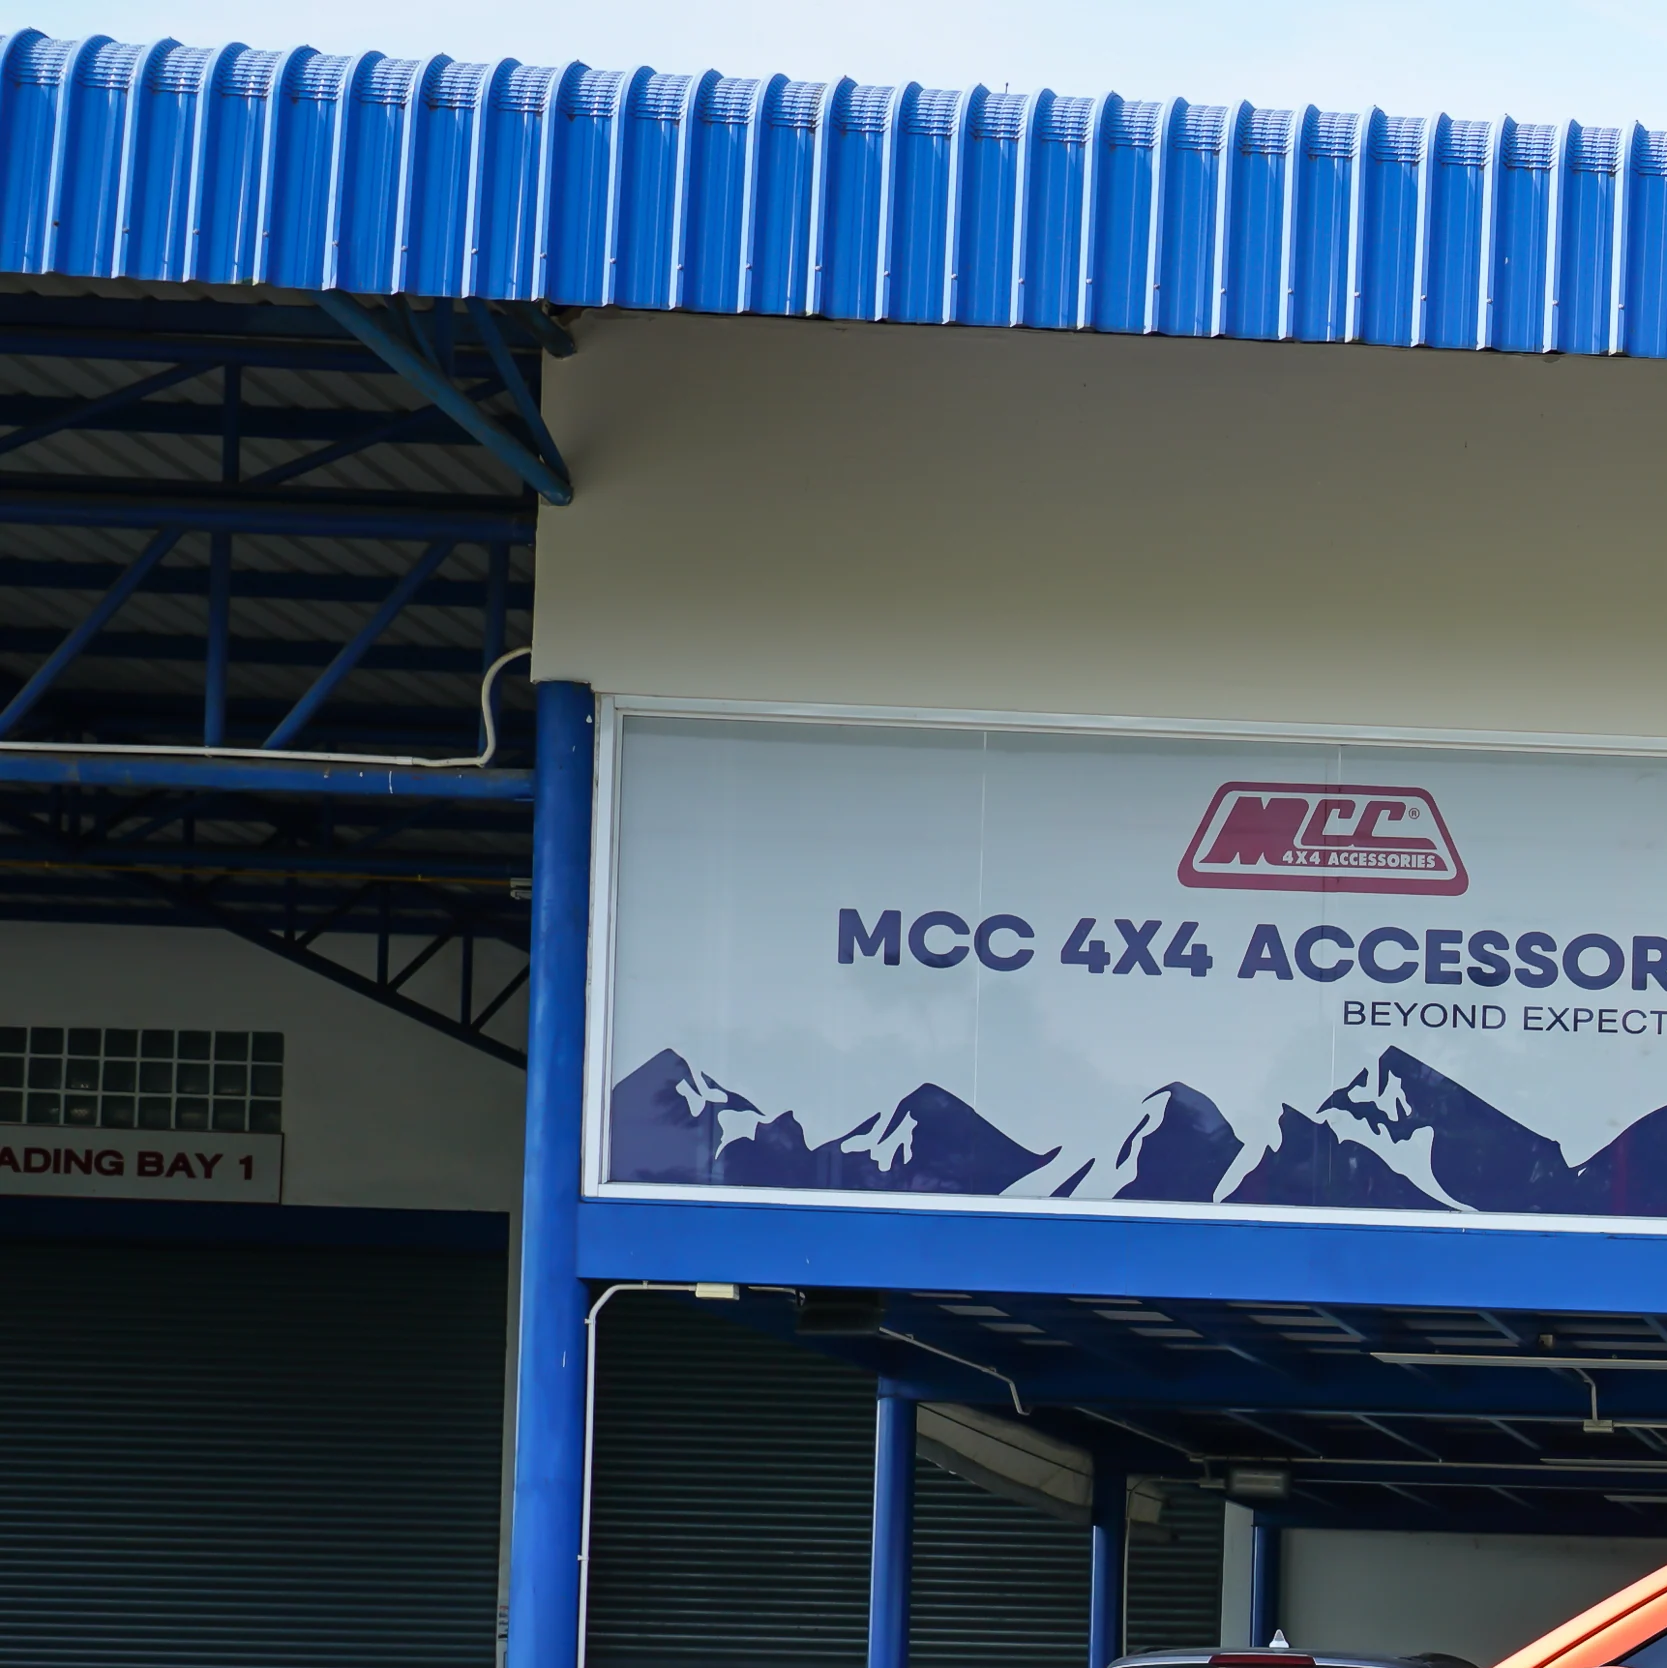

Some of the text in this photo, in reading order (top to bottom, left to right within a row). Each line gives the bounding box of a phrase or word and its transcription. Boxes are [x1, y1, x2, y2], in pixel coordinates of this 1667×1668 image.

[1199, 797, 1437, 865] MCC
[1282, 850, 1437, 869] 4X4 ACCESSORIES
[837, 908, 1035, 972] MCC
[1060, 917, 1213, 978] 4X4
[1342, 1000, 1508, 1031] BEYOND
[136, 1150, 224, 1180] BAY
[238, 1153, 255, 1181] 1
